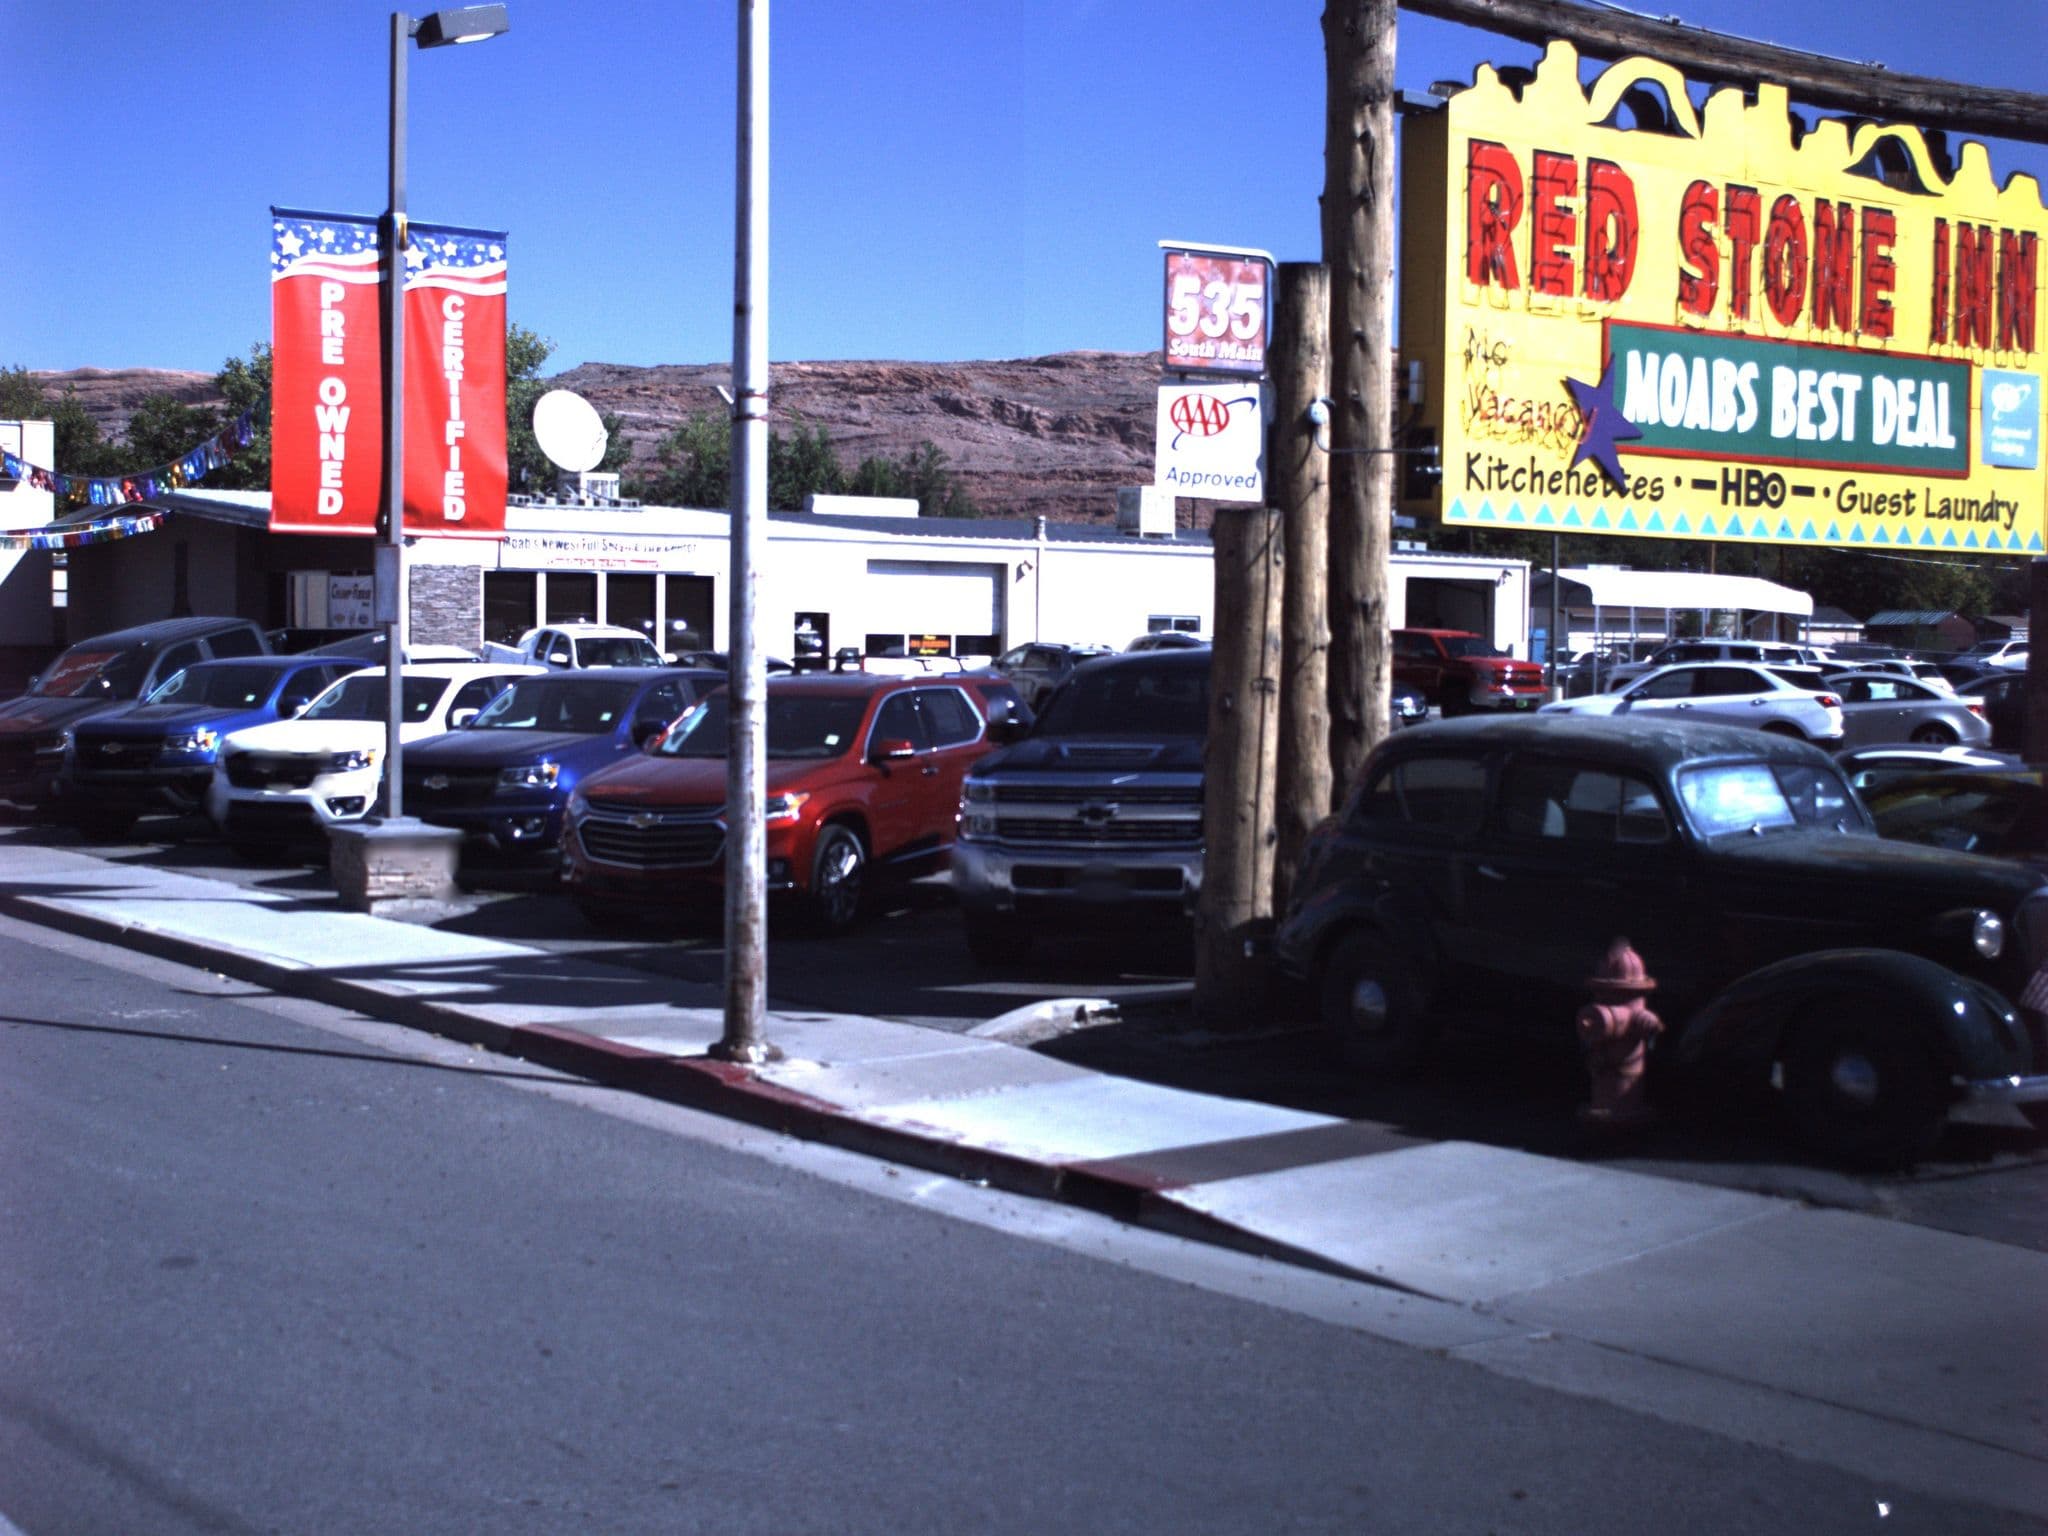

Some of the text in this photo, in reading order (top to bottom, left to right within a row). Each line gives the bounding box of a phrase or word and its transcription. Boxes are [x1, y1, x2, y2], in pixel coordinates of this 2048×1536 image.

[1466, 138, 2038, 355] RED STONE INN
[1168, 274, 1263, 340] 535
[1168, 338, 1263, 361] South Main
[315, 281, 350, 516] PRE OWNED
[442, 295, 466, 521] CERTIFIED
[1171, 394, 1229, 436] AAA
[1624, 350, 1956, 450] MOABS BEST DEAL
[1165, 466, 1257, 489] Approved
[1722, 468, 1786, 508] HBO
[1836, 480, 1916, 520] Guest
[1925, 488, 2019, 530] Laundry
